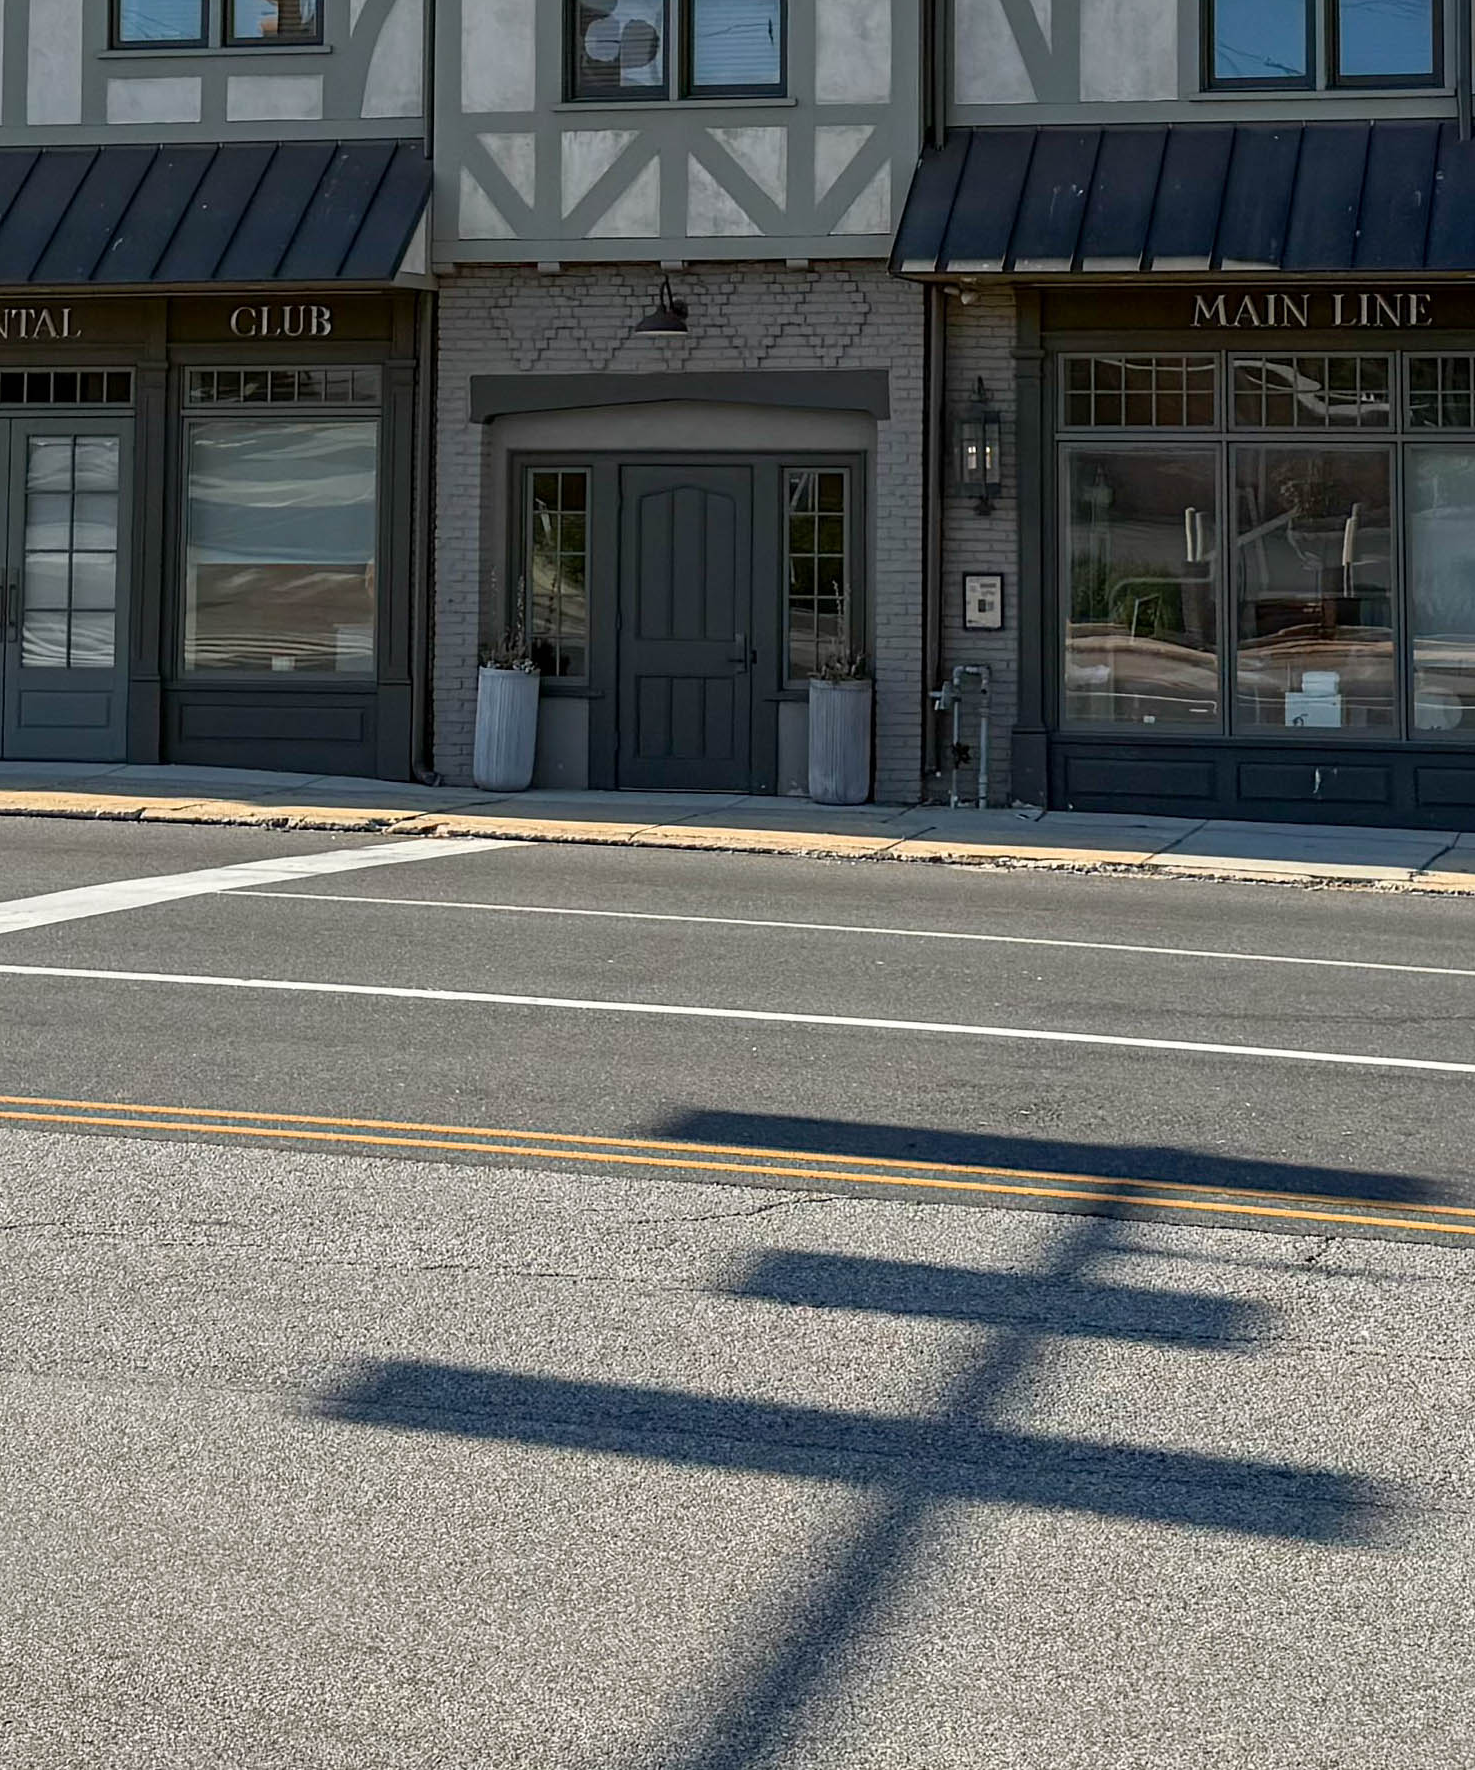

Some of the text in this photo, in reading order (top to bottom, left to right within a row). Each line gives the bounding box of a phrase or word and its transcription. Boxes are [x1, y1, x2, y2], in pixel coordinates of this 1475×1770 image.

[230, 305, 331, 337] CLUB
[1190, 294, 1433, 327] MAIN LINE
